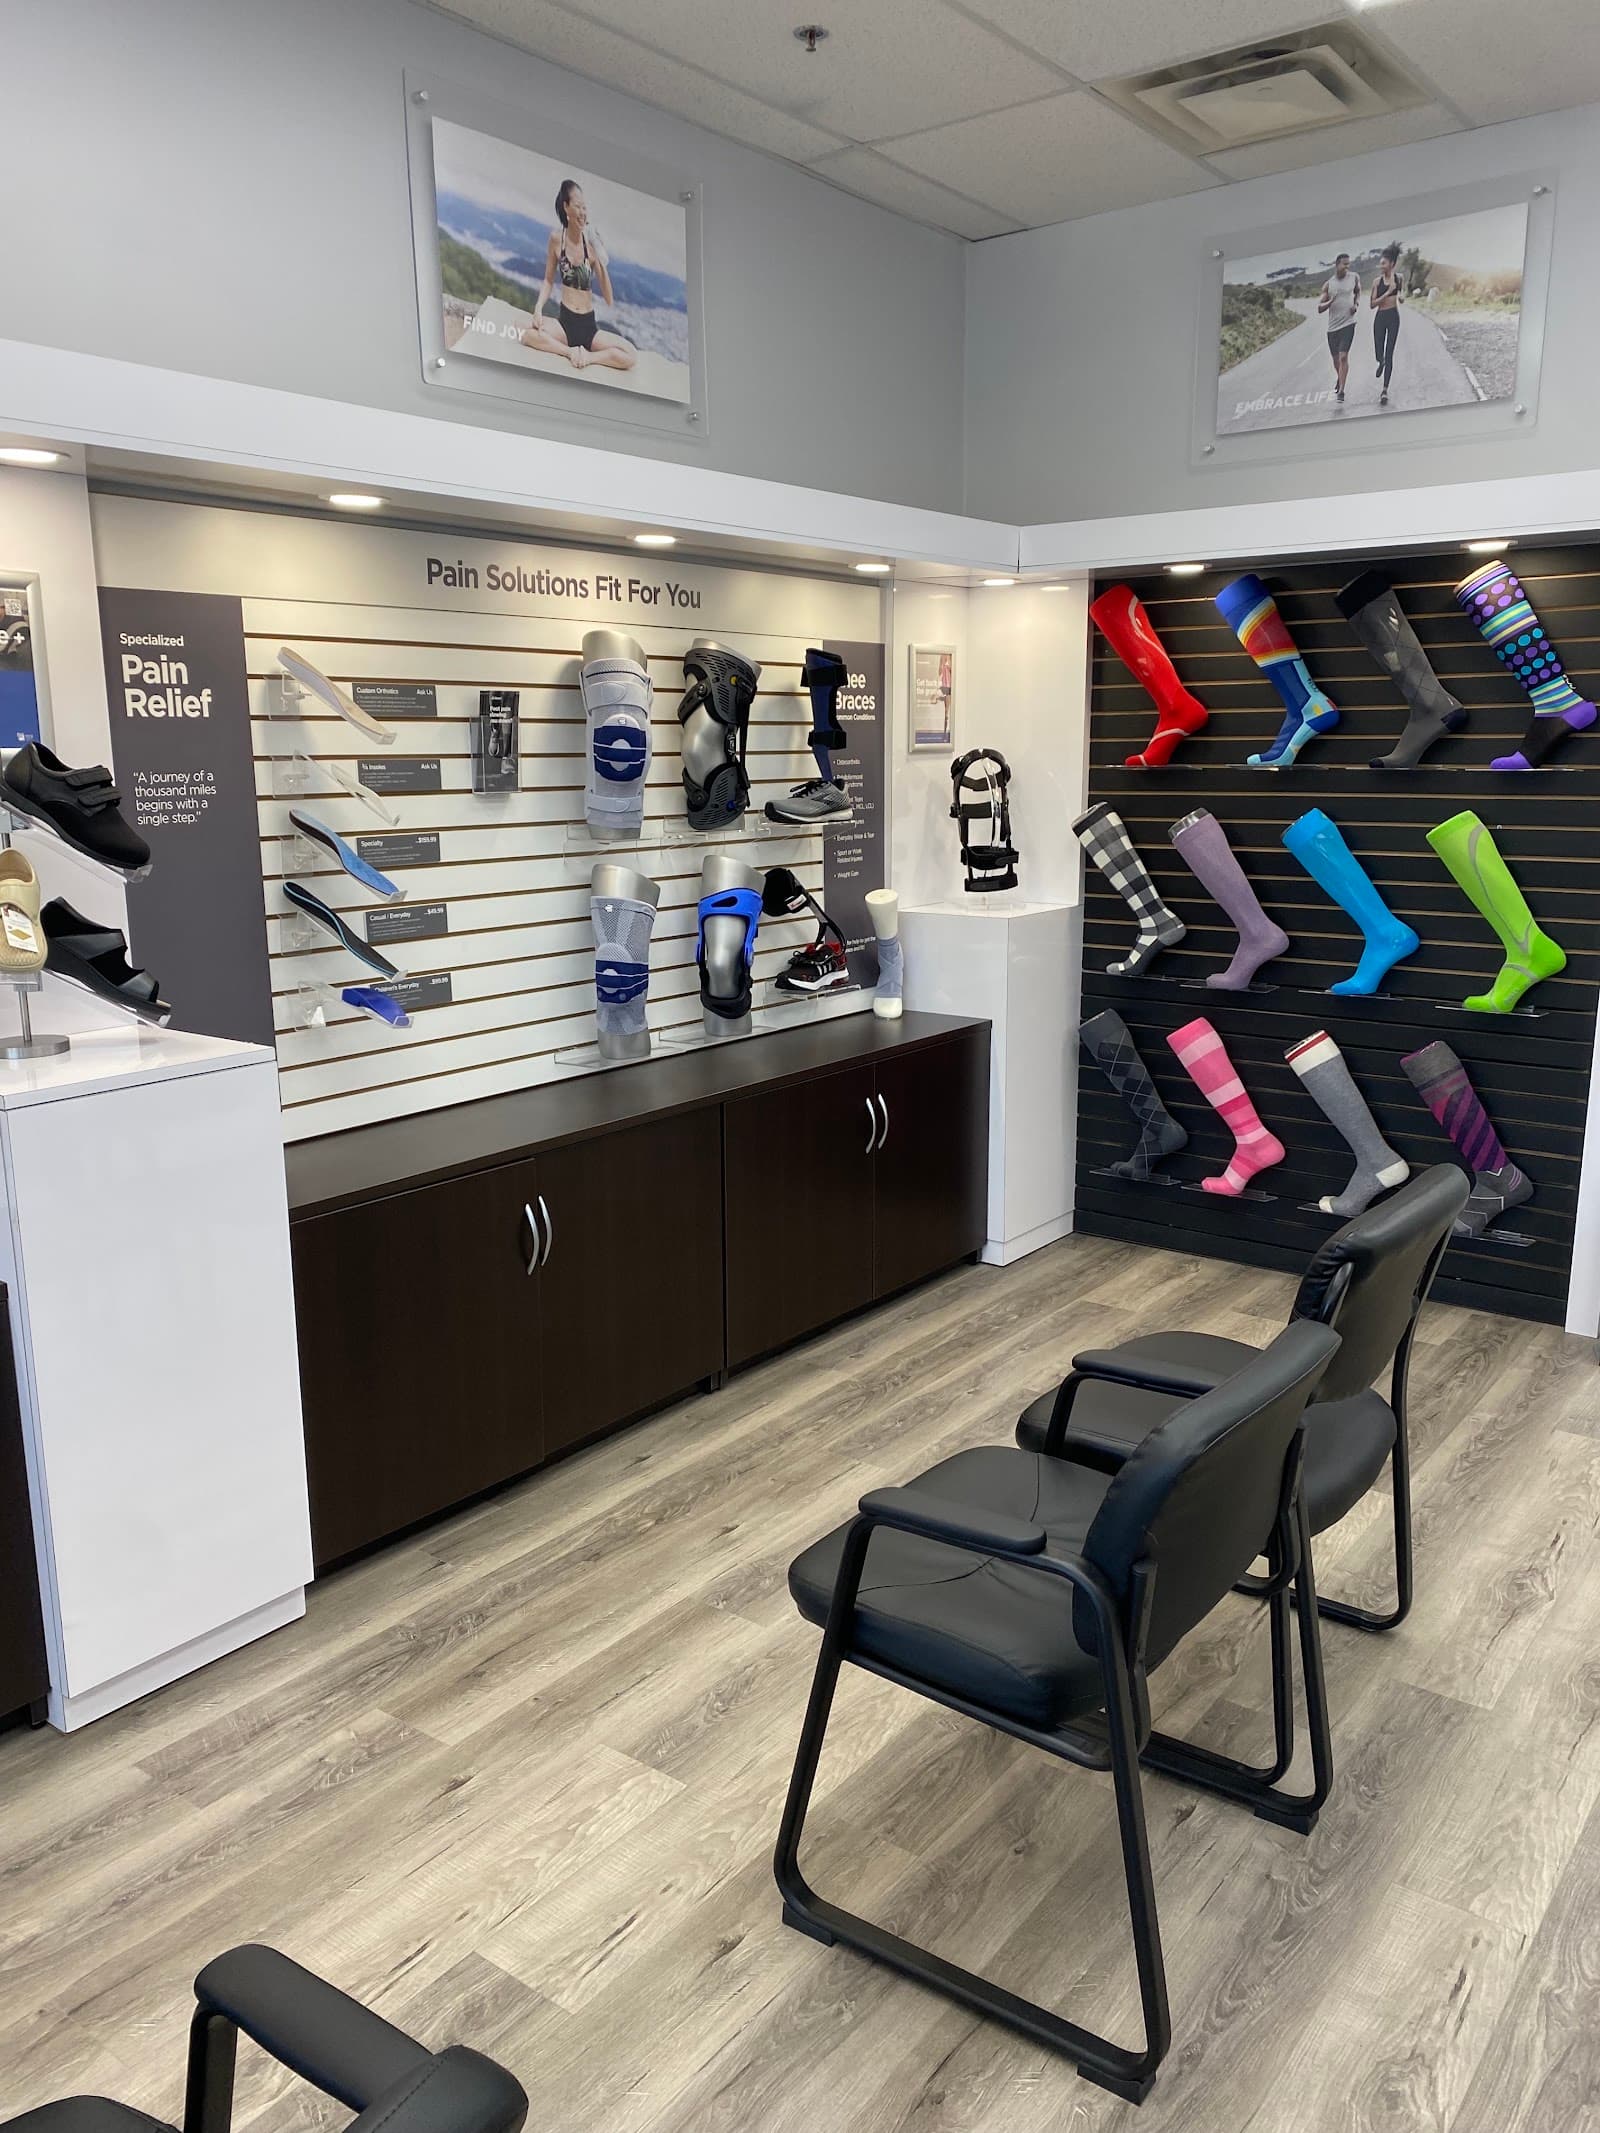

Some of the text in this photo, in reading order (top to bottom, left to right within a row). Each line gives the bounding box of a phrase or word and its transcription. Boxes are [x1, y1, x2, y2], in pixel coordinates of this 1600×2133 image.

[463, 314, 526, 341] FIND JOY
[1234, 393, 1303, 414] EMBRACE
[427, 558, 701, 609] Pain Solutions Fit For You
[120, 632, 184, 647] Specialized
[121, 653, 189, 685] Pain
[356, 686, 399, 695] Custom Orthotics
[416, 688, 426, 696] Ask
[124, 687, 213, 718] Relief
[149, 771, 190, 785] journey
[193, 770, 204, 782] of
[206, 772, 214, 781] a
[135, 784, 217, 797] thousand miles
[136, 797, 209, 813] begins with a
[137, 813, 169, 827] single
[390, 911, 411, 919] Everyday
